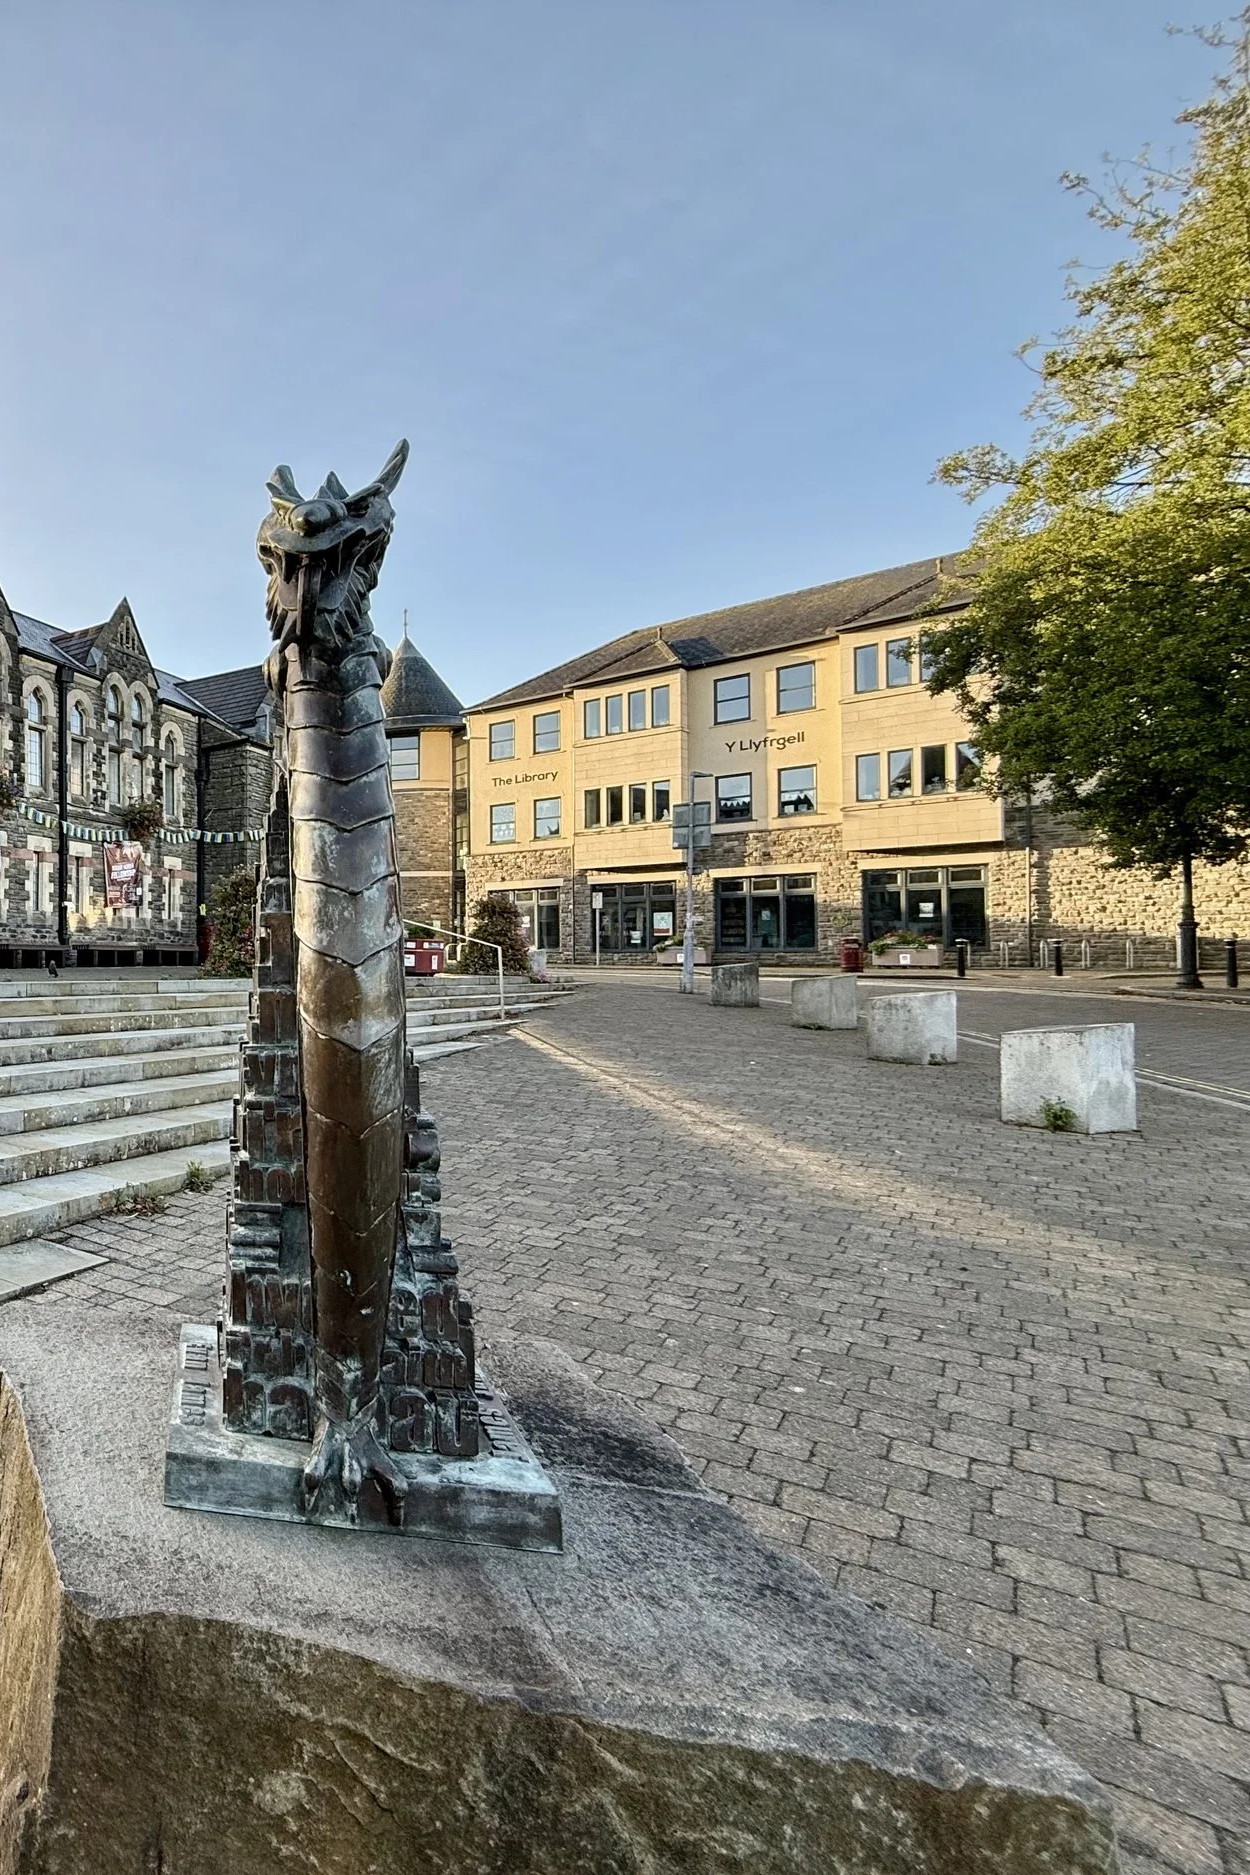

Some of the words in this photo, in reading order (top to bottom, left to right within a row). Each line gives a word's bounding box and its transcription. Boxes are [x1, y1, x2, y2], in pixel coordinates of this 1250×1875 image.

[725, 741, 736, 753] Y
[739, 731, 805, 751] Llyfrgell
[491, 777, 513, 787] The
[514, 771, 559, 784] Library
